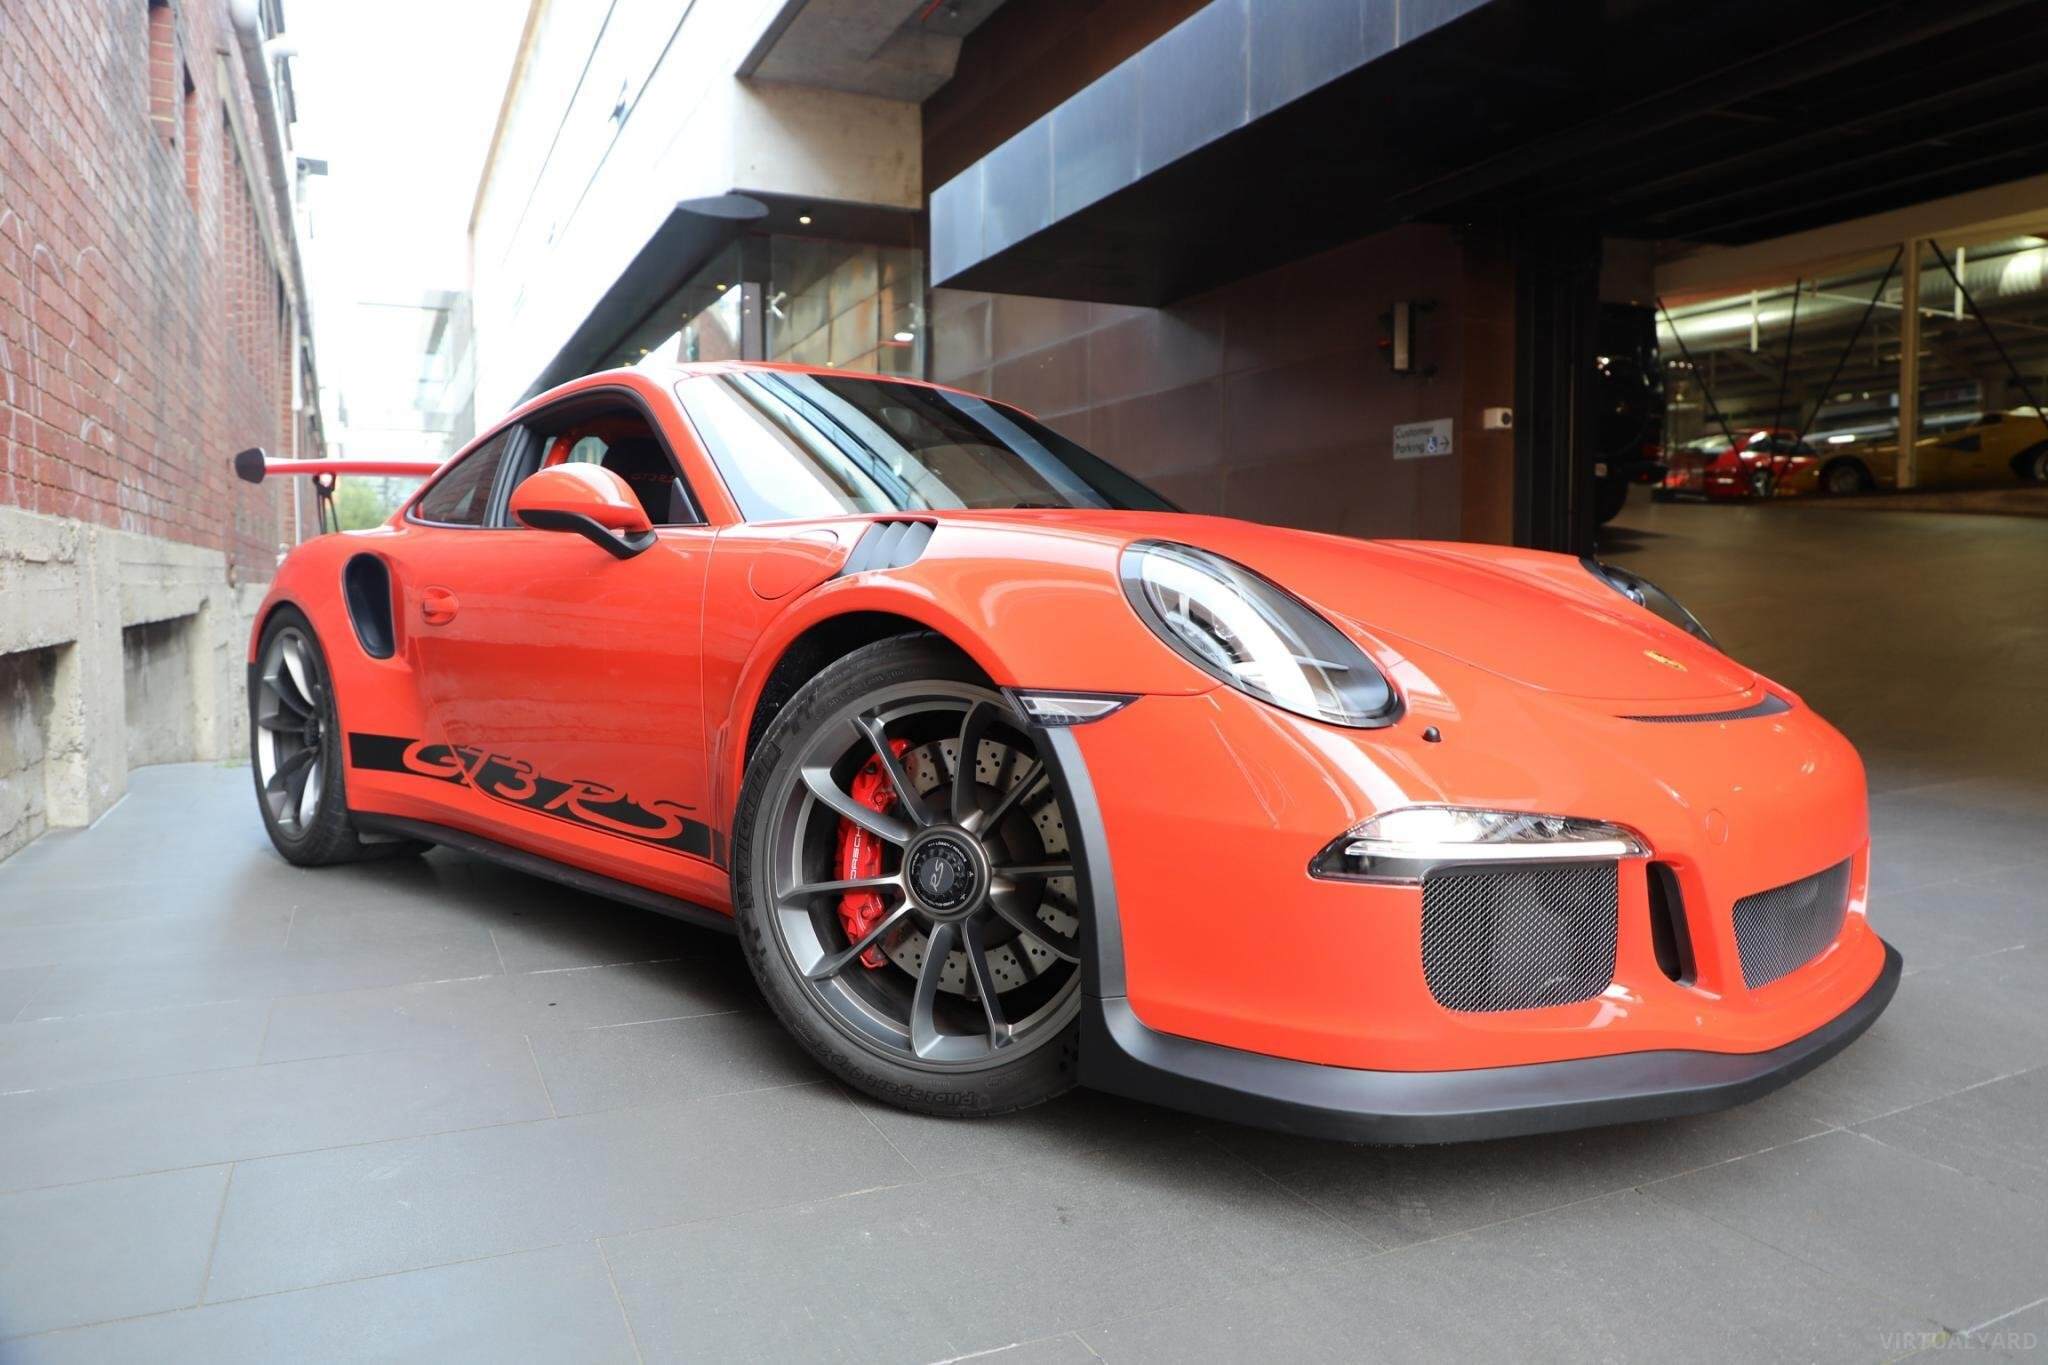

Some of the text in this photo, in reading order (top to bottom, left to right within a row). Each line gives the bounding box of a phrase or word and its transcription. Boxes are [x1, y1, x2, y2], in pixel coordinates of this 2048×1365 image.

[1395, 427, 1434, 440] Customer
[1395, 442, 1425, 454] Parking
[402, 739, 697, 840] GT3 RS
[850, 825, 861, 881] ORSCH
